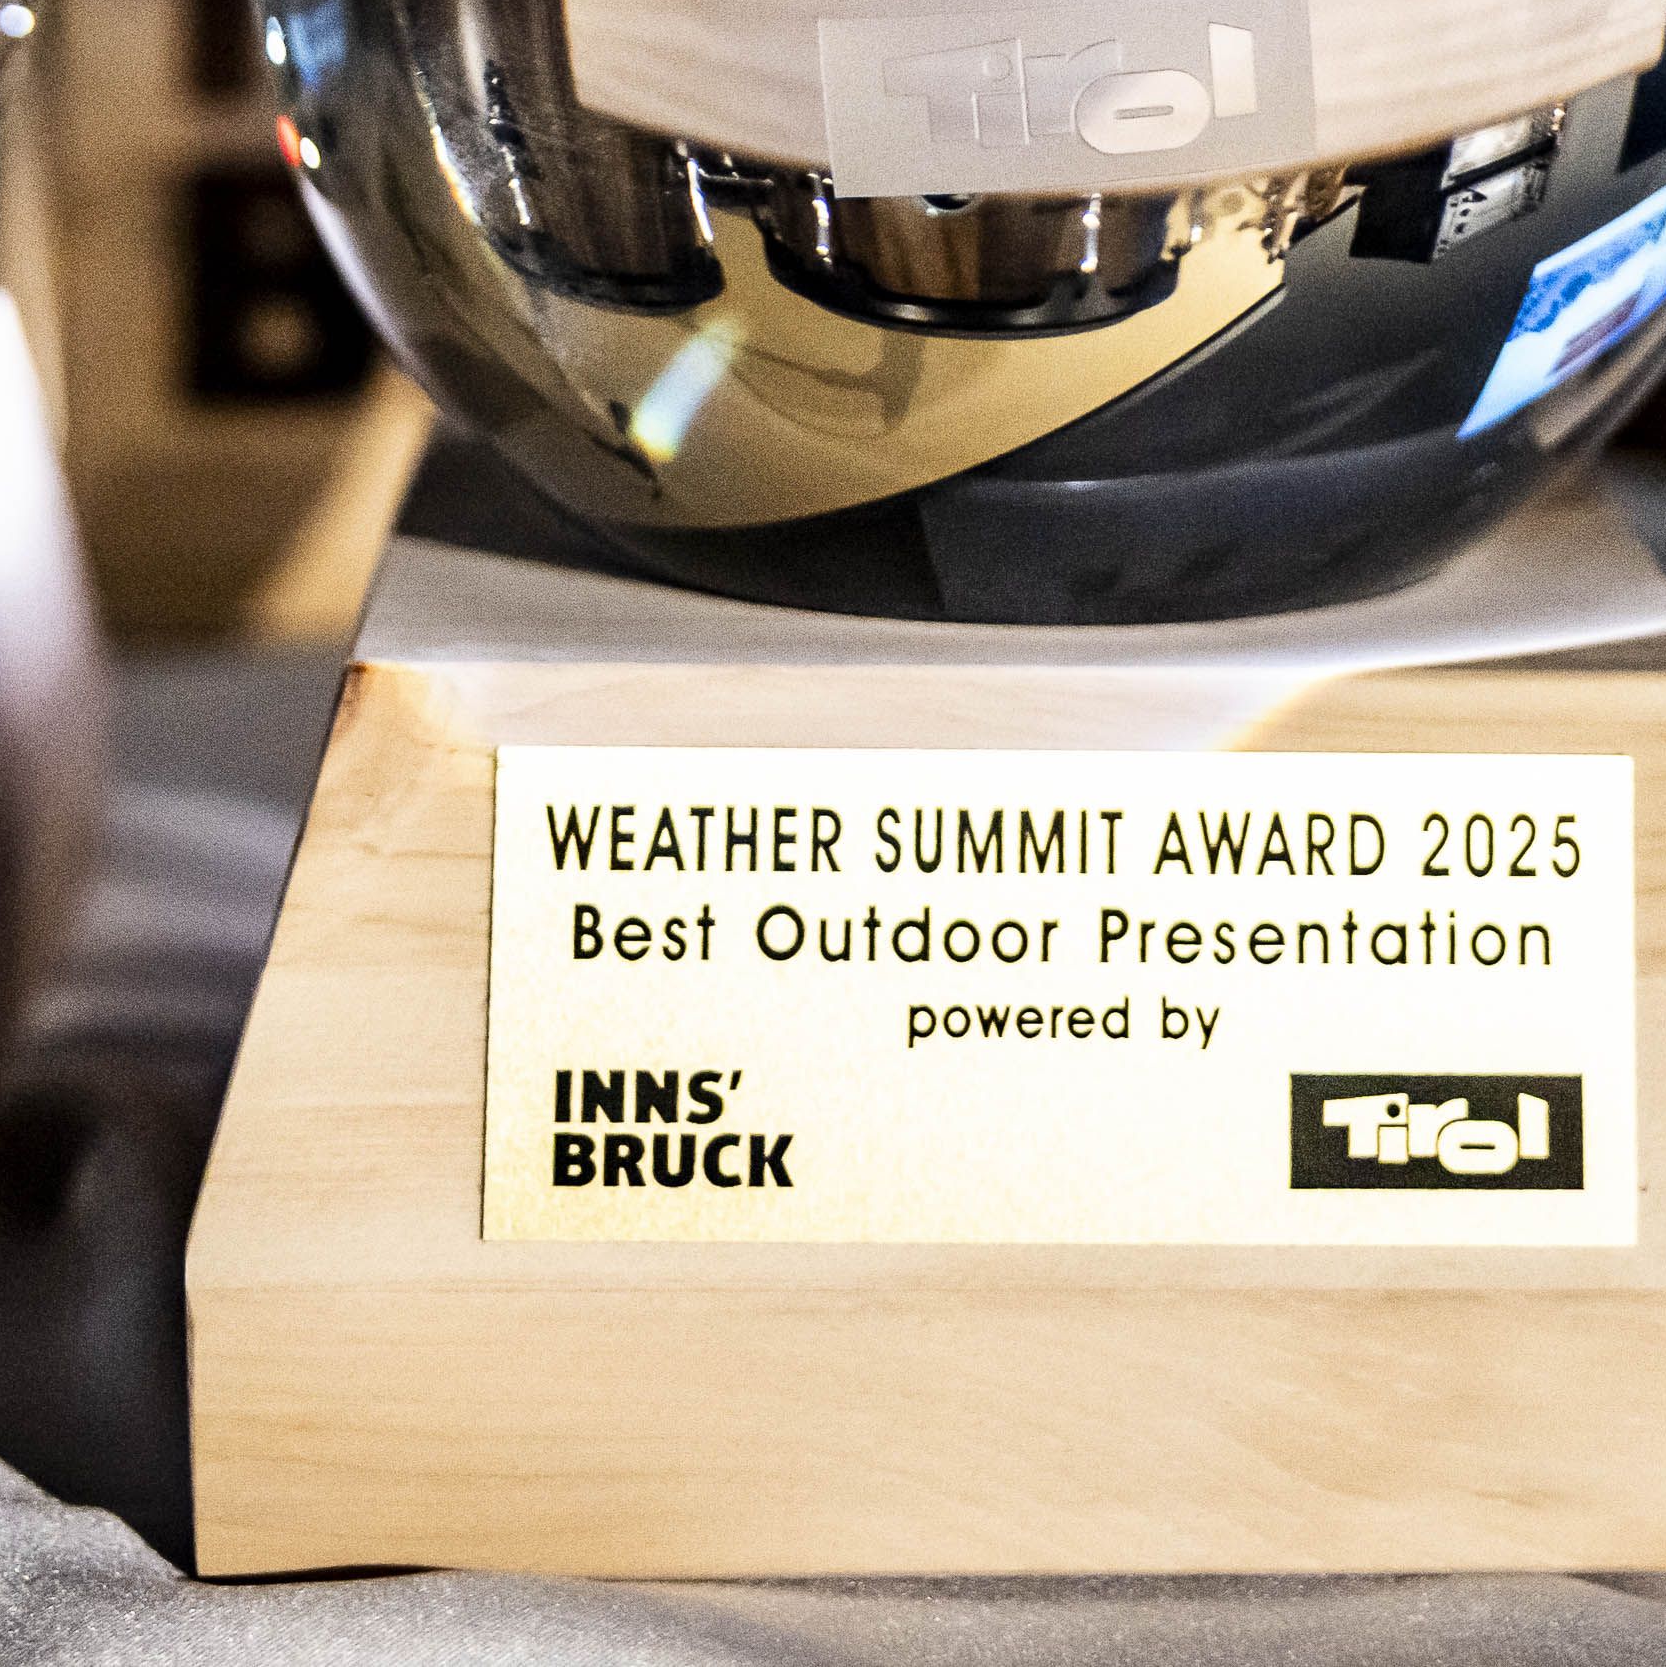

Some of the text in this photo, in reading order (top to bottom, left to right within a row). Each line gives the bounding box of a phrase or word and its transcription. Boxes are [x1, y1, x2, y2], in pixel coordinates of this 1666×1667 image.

[884, 22, 1259, 154] Tirol
[546, 804, 1581, 878] WEATHER SUMMIT AWARD 2025
[572, 903, 1551, 966] Best Outdoor Presentation
[908, 996, 1221, 1050] powered by
[553, 1068, 744, 1125] INNS'
[551, 1132, 795, 1188] BRUCK
[1322, 1091, 1551, 1175] Tirol
